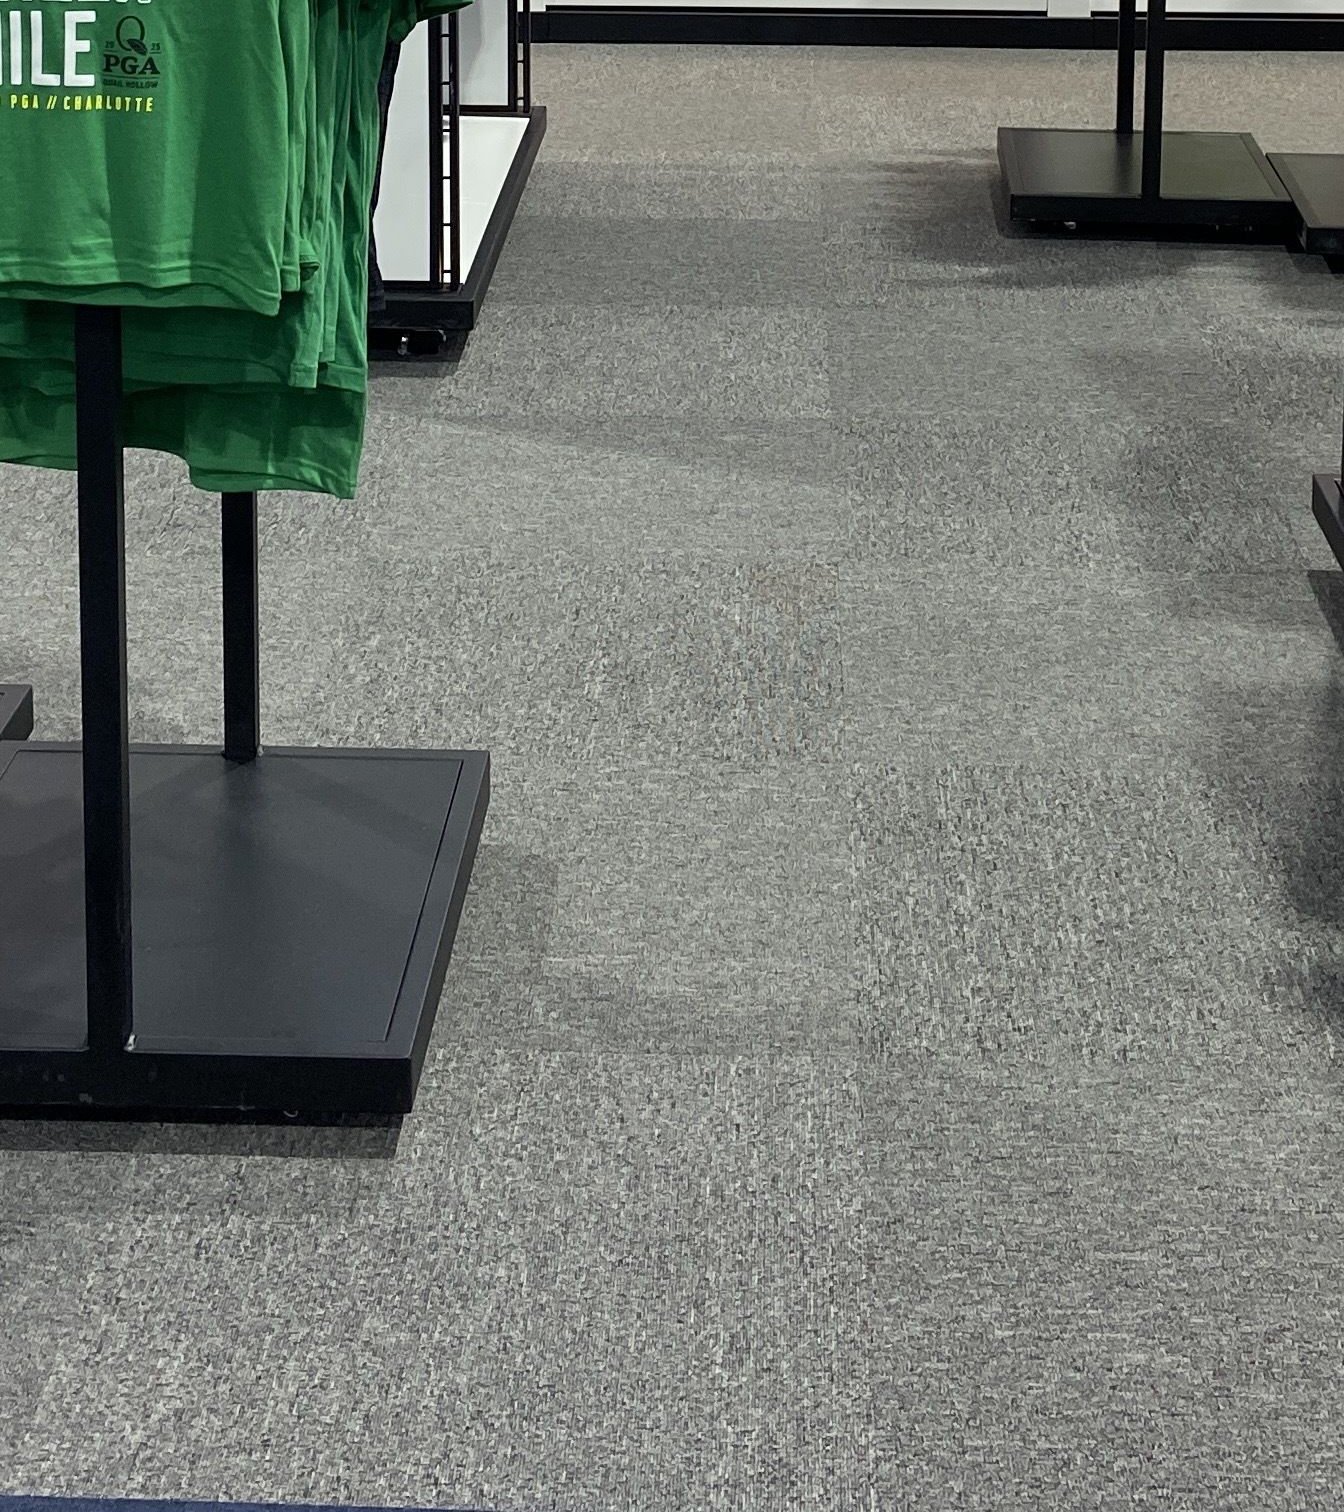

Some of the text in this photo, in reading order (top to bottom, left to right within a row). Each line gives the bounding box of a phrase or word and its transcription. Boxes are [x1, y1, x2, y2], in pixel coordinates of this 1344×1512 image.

[102, 54, 160, 74] PGA
[11, 94, 39, 109] PGA
[63, 94, 153, 112] CHARLOTTE
